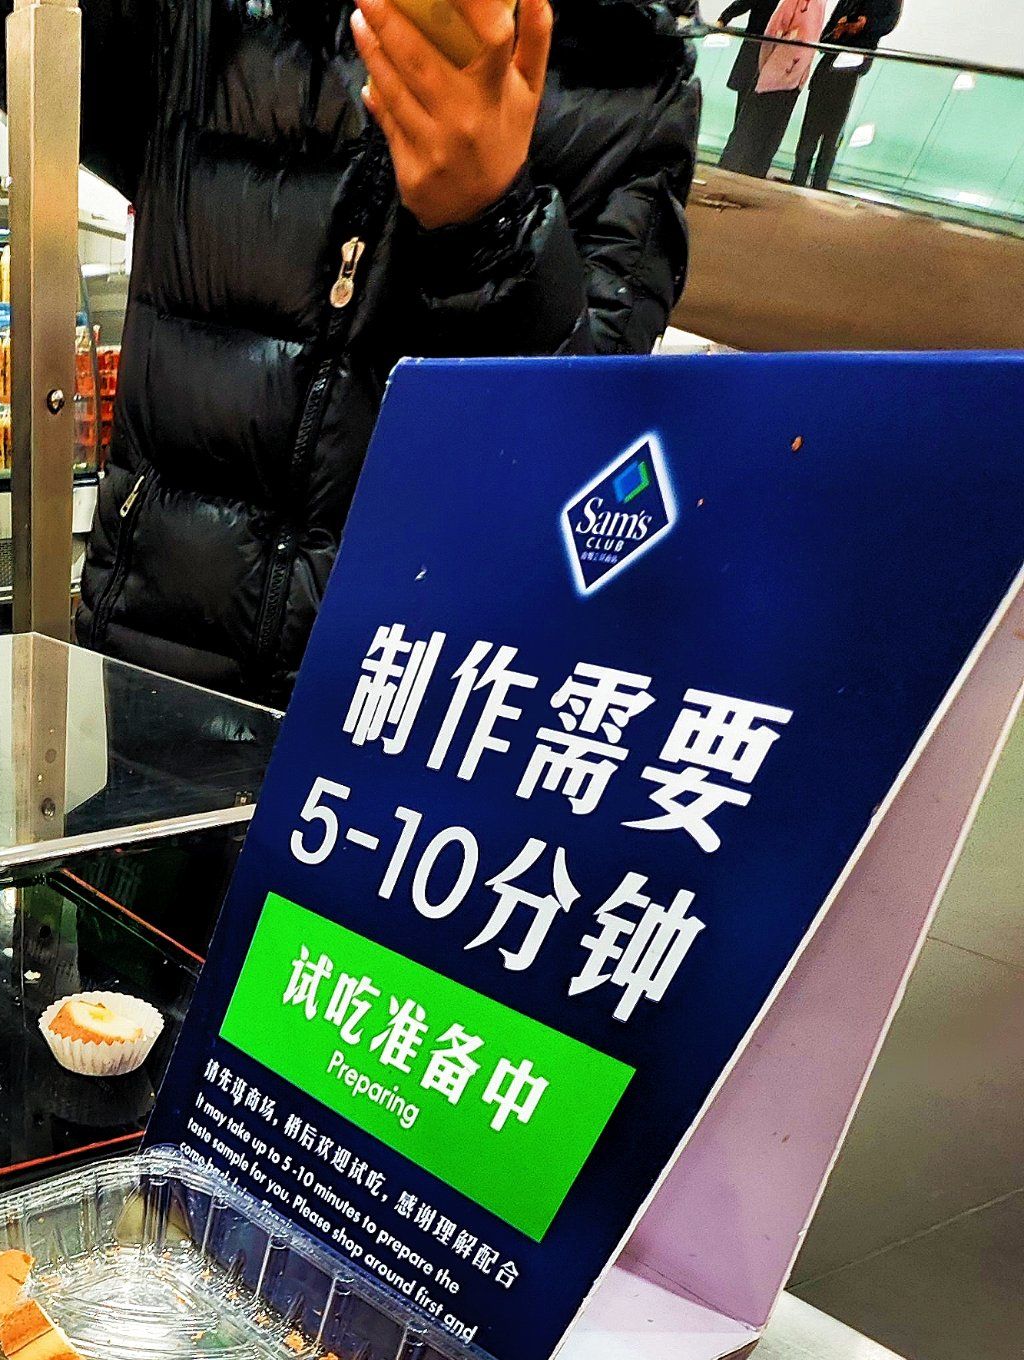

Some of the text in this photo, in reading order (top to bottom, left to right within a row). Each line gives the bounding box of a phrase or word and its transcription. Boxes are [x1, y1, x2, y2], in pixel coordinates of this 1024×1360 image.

[576, 496, 653, 541] Sam's
[586, 536, 625, 552] CLUB
[342, 623, 794, 853] 制作需要
[290, 776, 706, 1022] 5-10分钟
[282, 943, 550, 1132] 试吃准备中
[326, 1049, 420, 1129] Preparing
[187, 1117, 212, 1143] taste
[212, 1137, 249, 1172] sample
[249, 1161, 268, 1184] for
[265, 1179, 291, 1204] you.
[292, 1194, 332, 1233] Please
[331, 1227, 364, 1258] shop
[363, 1253, 417, 1296] around
[414, 1285, 444, 1317] first
[443, 1313, 479, 1345] and
[194, 1091, 205, 1109] It
[203, 1101, 228, 1127] may
[226, 1117, 251, 1143] take
[251, 1136, 268, 1155] up
[267, 1146, 281, 1164] to
[313, 1181, 362, 1224] minutes
[361, 1215, 377, 1234] to
[375, 1229, 434, 1276] prepare
[434, 1268, 460, 1294] the
